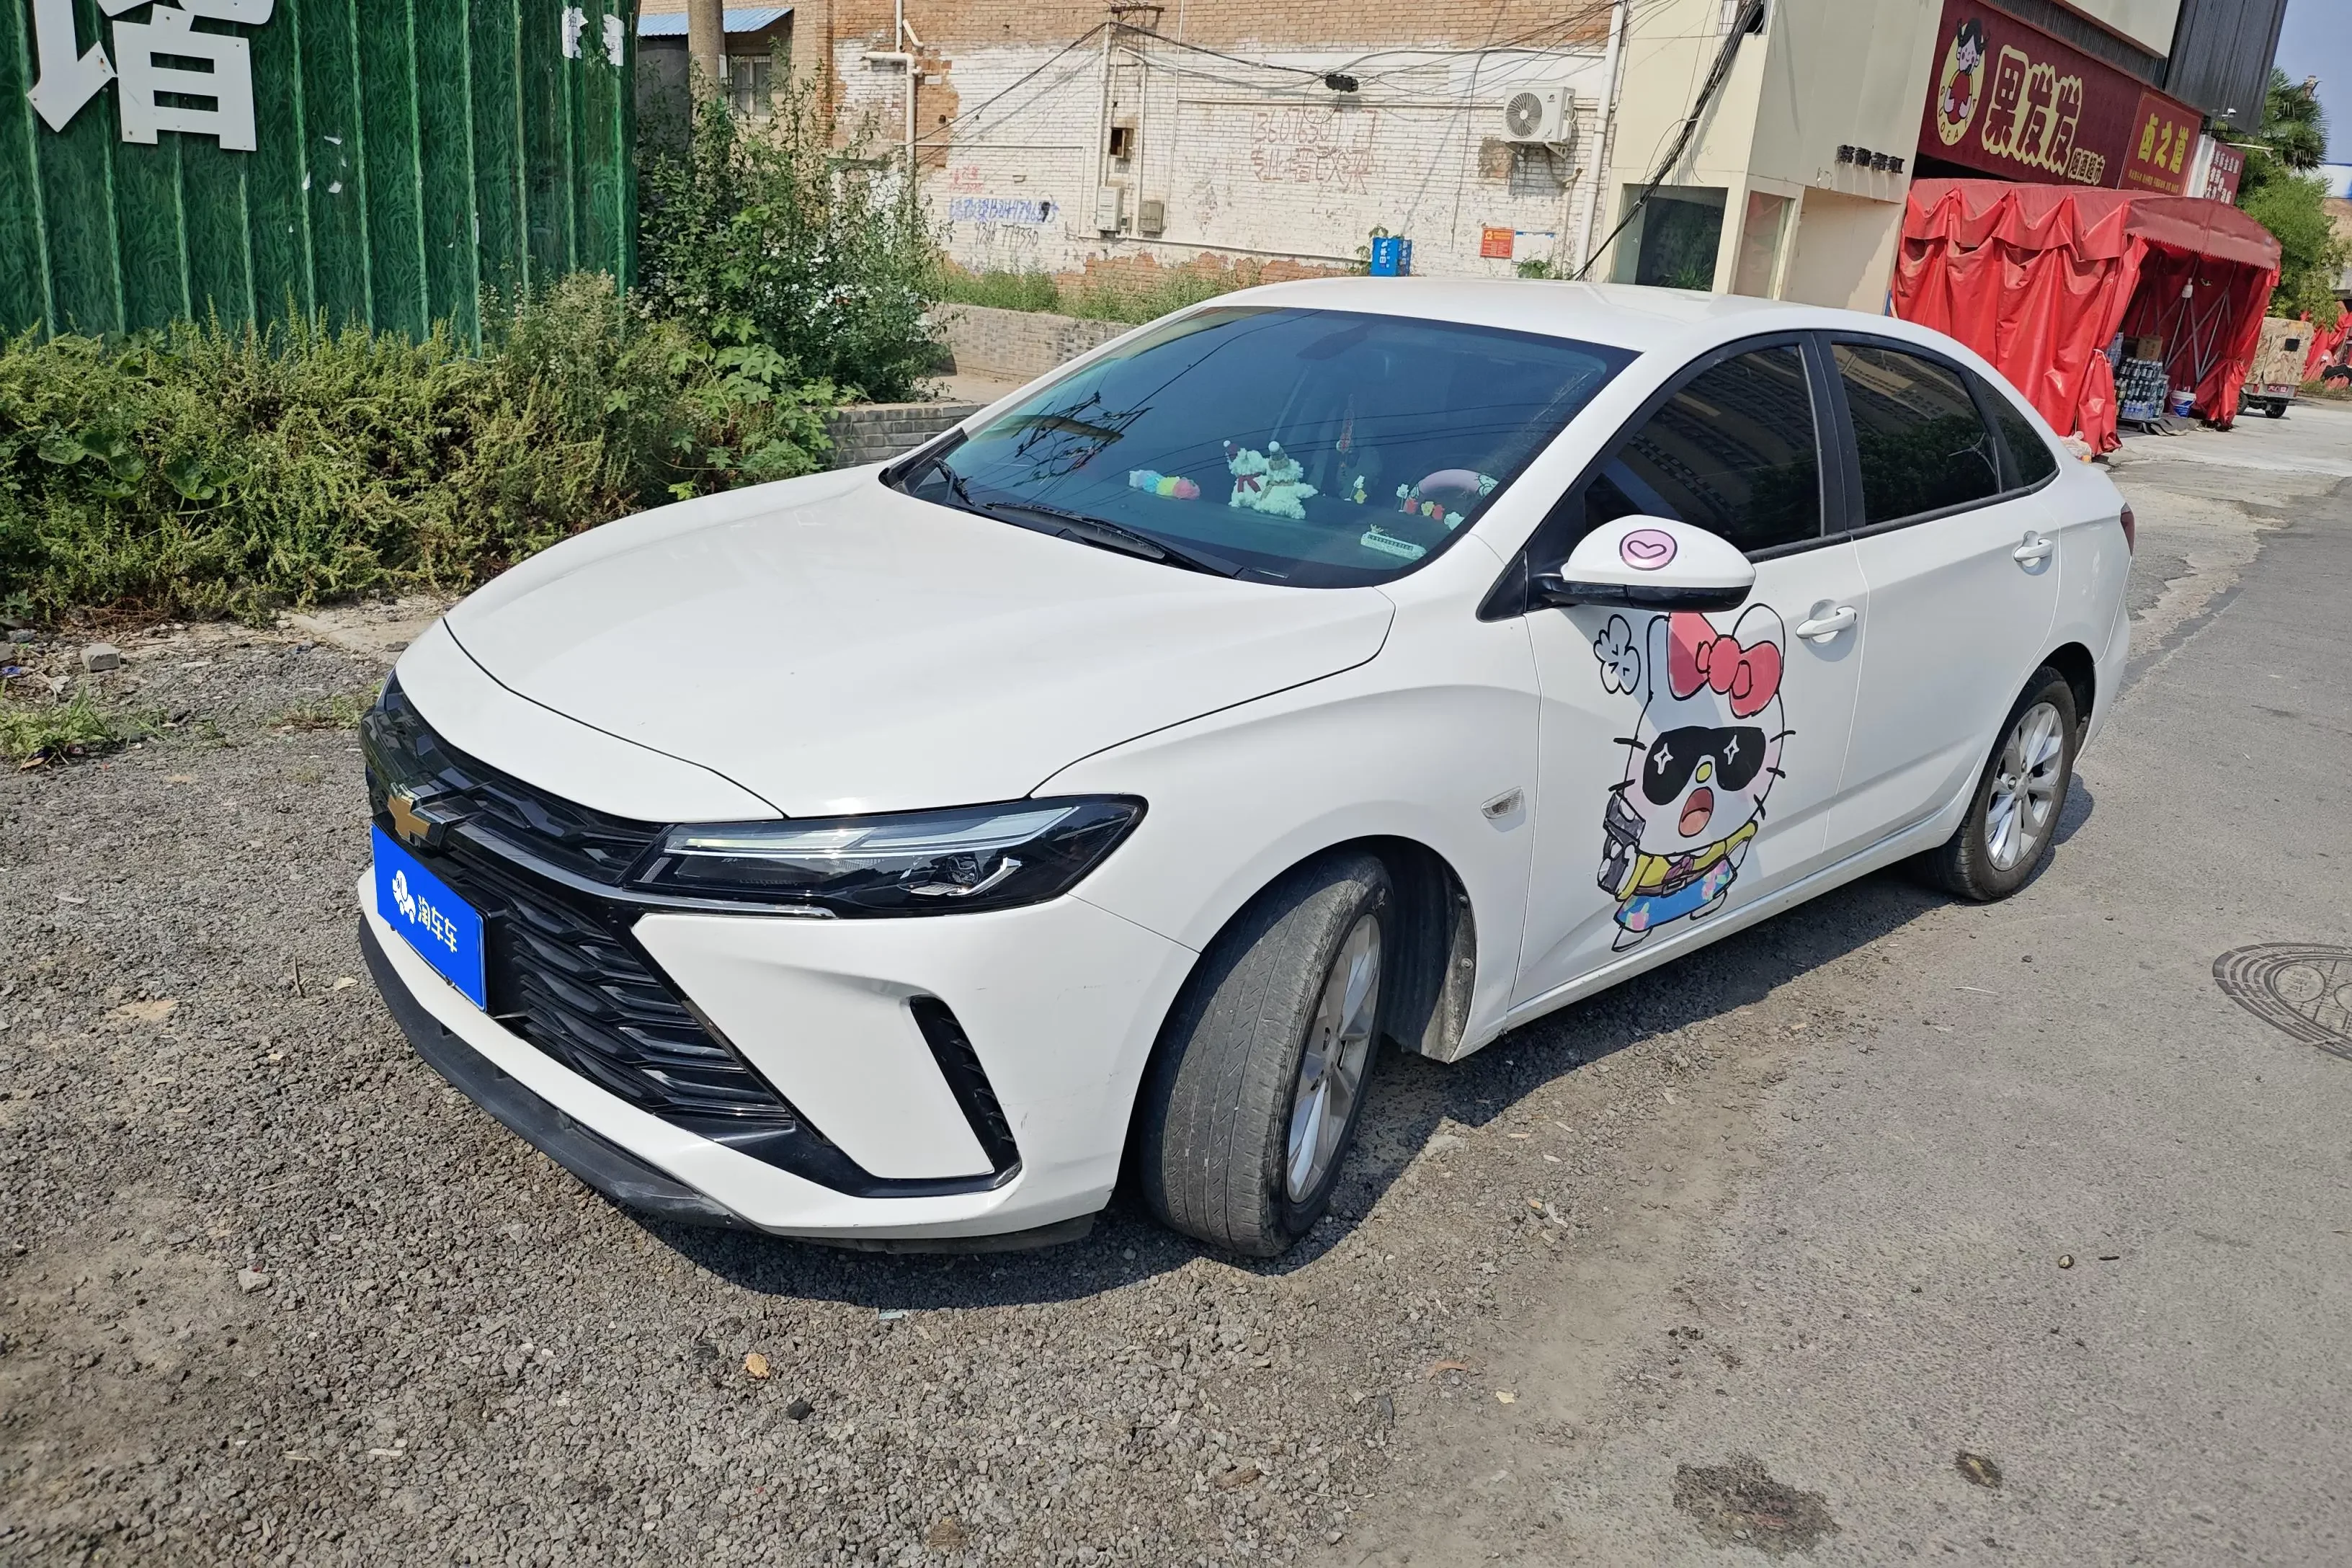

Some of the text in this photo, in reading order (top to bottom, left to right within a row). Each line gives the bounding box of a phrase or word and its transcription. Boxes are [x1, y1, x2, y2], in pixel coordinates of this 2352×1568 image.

[1983, 48, 2082, 174] 果发发
[2137, 112, 2190, 174] 卤之道
